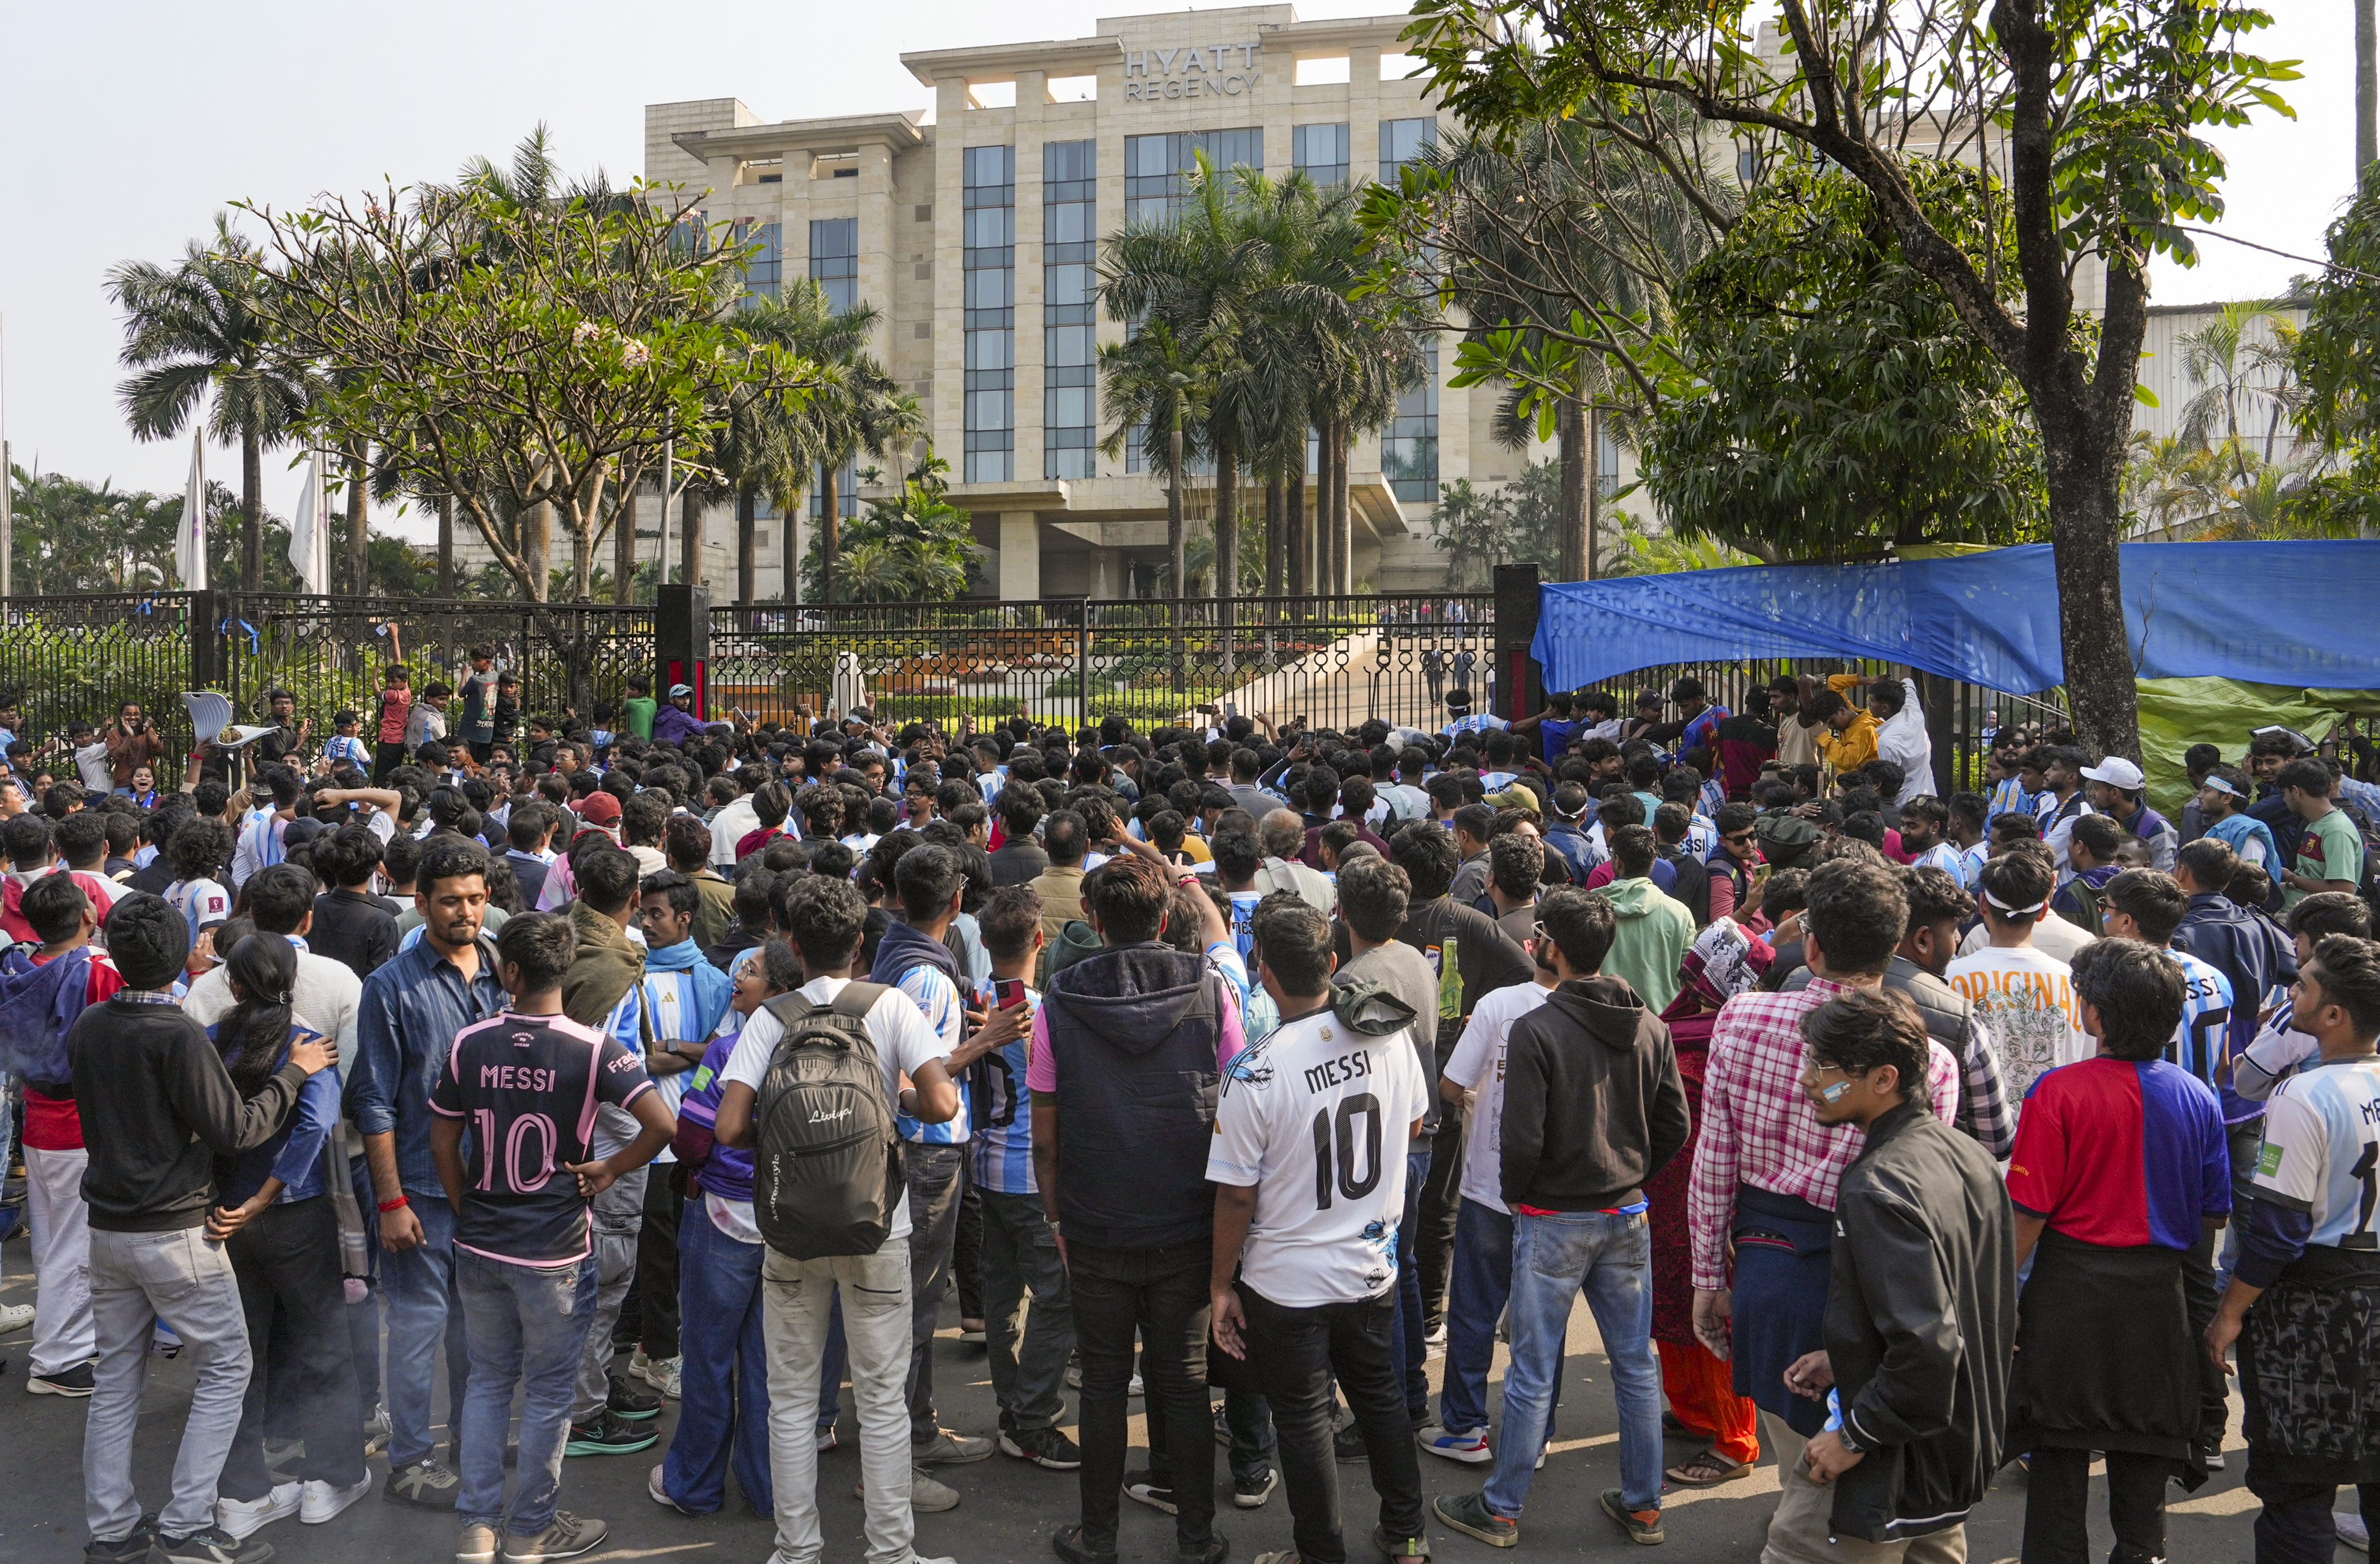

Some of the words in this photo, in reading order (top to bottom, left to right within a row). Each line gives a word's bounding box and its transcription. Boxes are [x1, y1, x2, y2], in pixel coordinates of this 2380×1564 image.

[1127, 43, 1259, 77] HYATT
[1126, 74, 1259, 102] REGENCY
[2184, 976, 2221, 1001] SSI
[512, 1032, 535, 1040] FREEDOM
[480, 1065, 555, 1092] MESSI
[1304, 1050, 1371, 1094] MESSI
[474, 1108, 557, 1195] 10
[1313, 1092, 1381, 1210] 10
